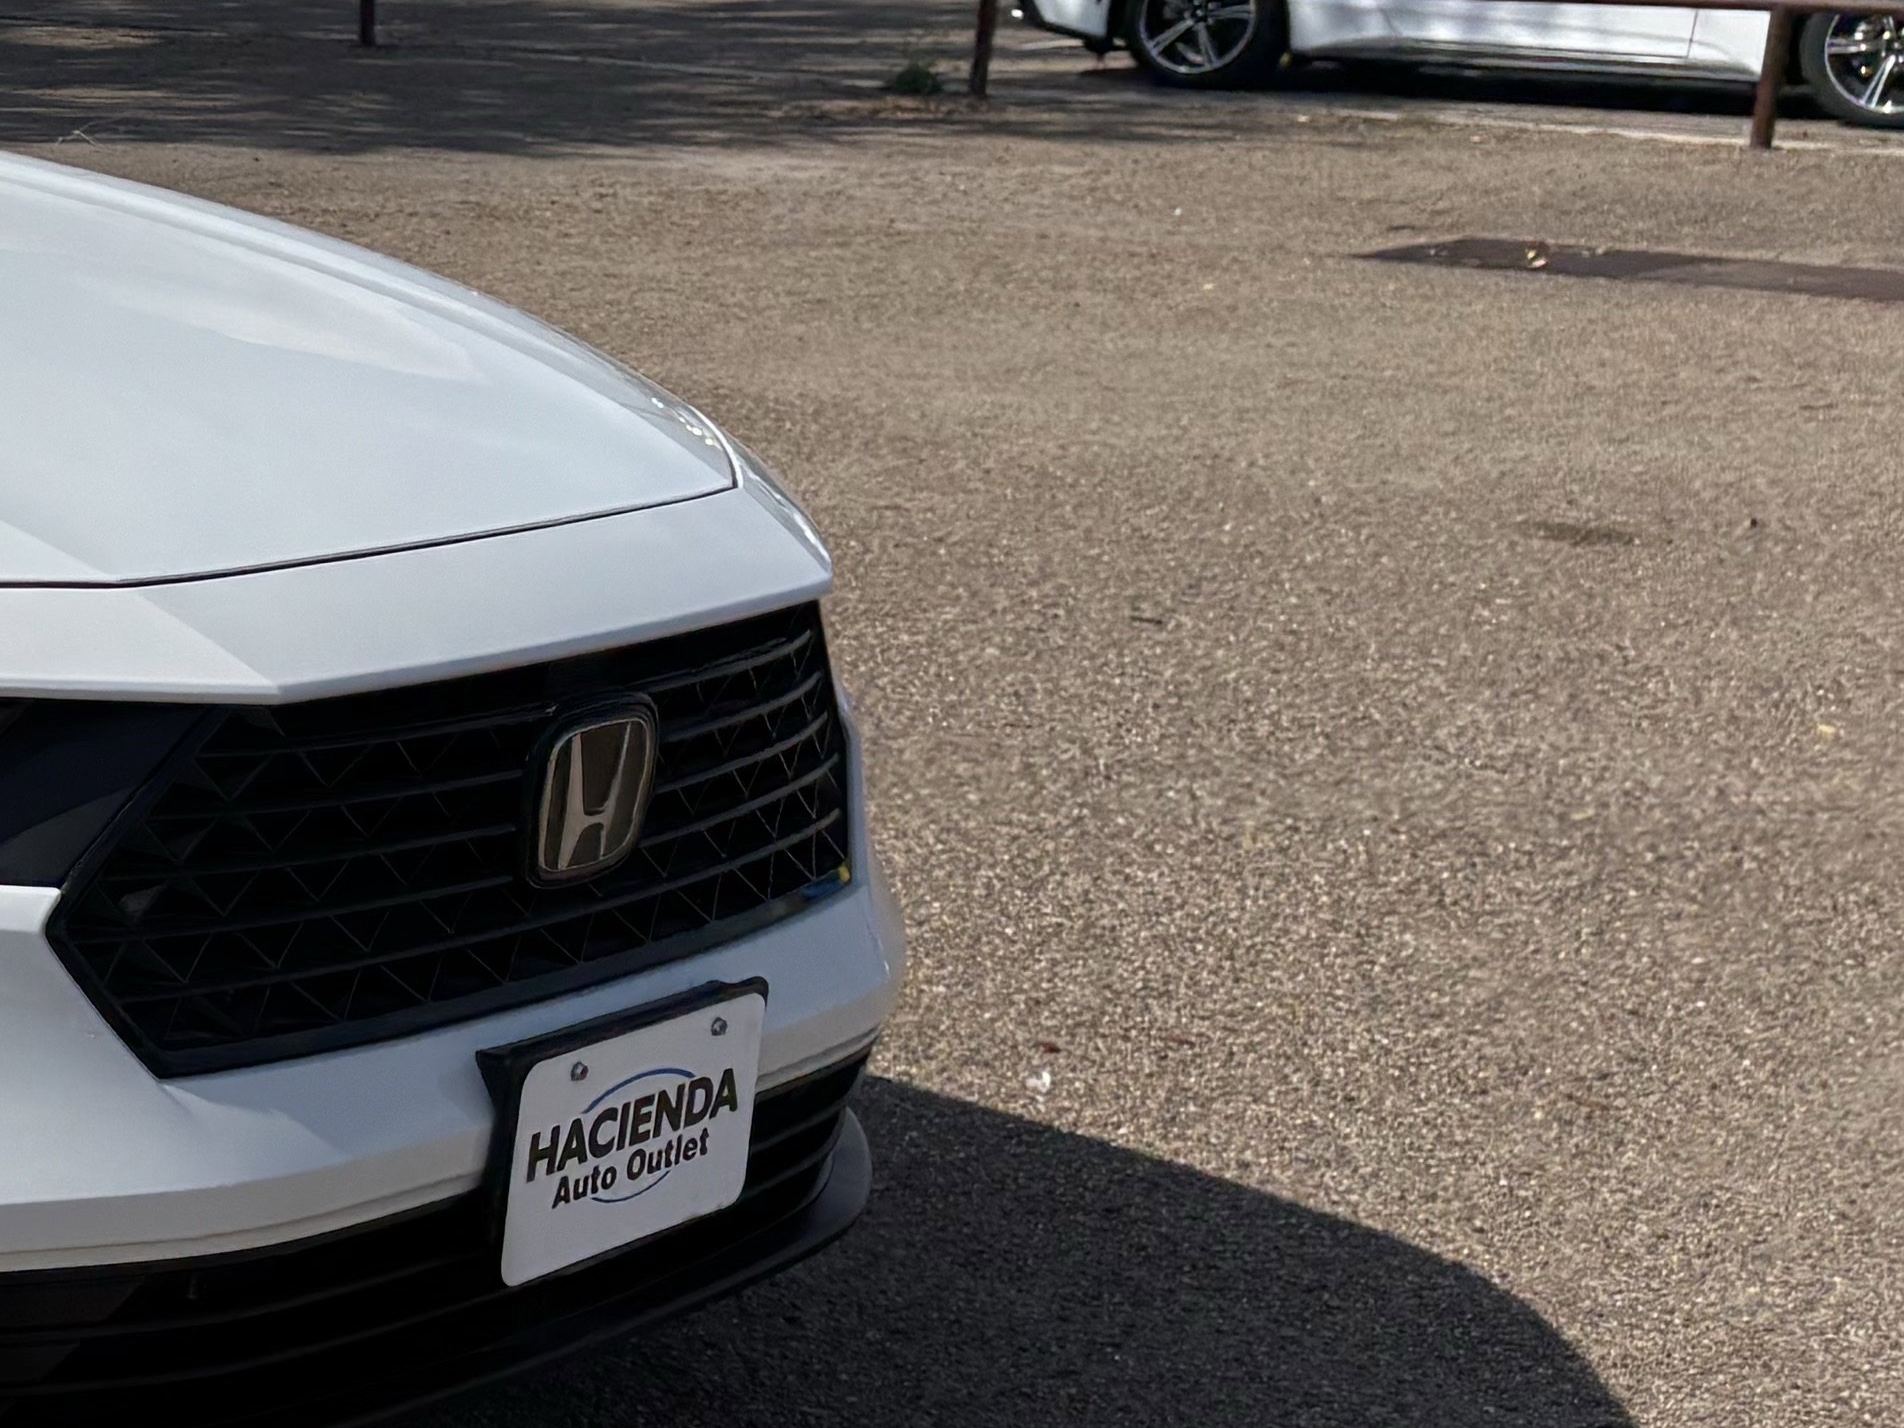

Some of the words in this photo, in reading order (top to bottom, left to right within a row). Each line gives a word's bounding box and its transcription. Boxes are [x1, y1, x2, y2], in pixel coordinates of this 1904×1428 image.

[526, 1068, 738, 1183] HACIENDA
[551, 1165, 617, 1210] Auto
[626, 1127, 710, 1181] Outlet
